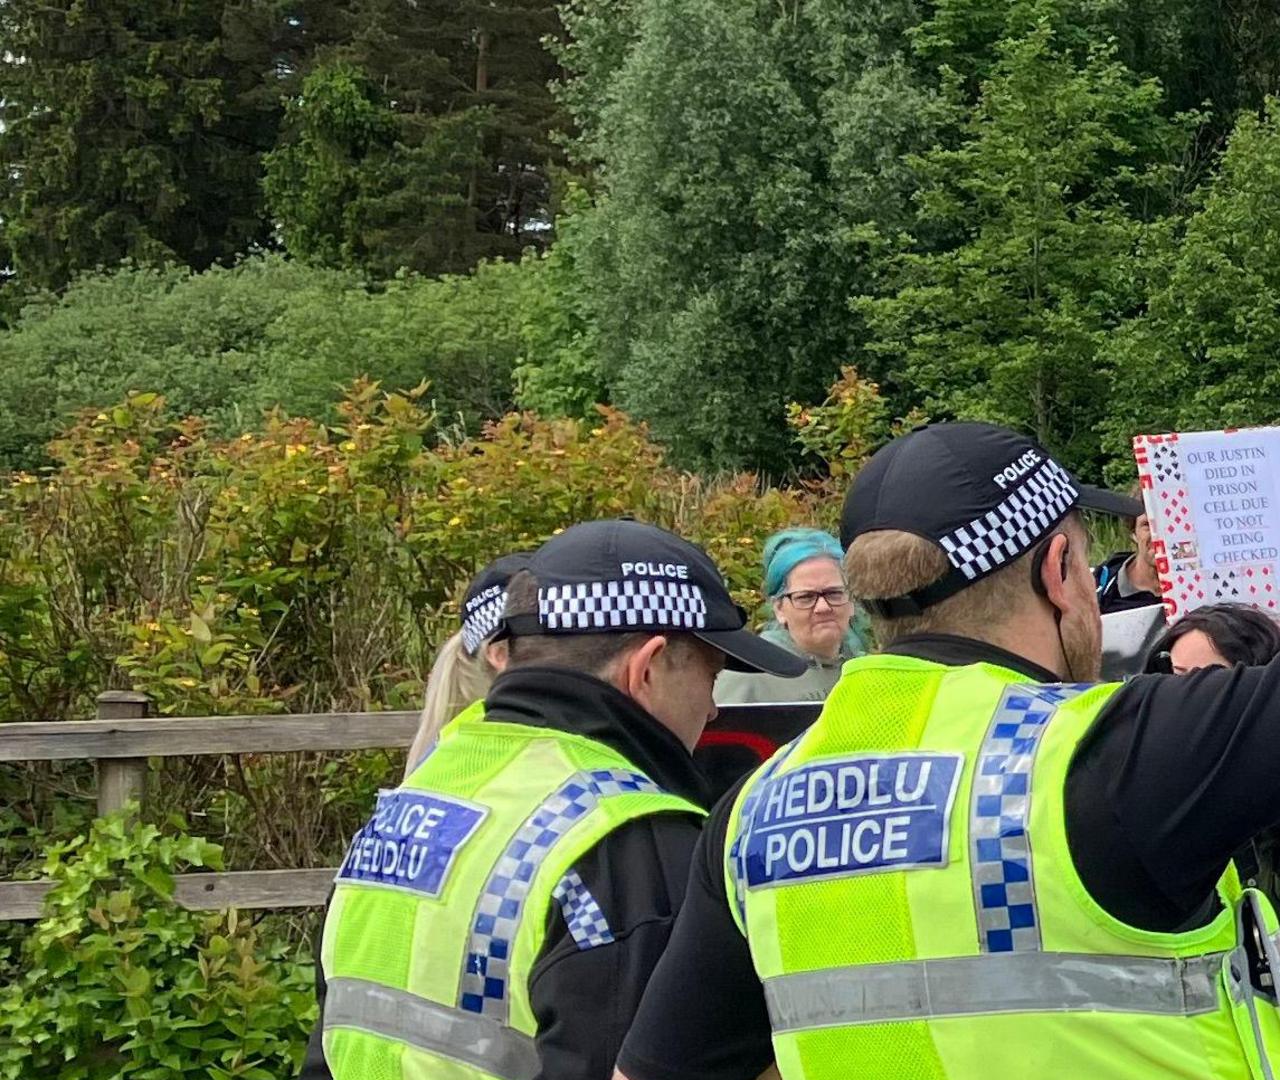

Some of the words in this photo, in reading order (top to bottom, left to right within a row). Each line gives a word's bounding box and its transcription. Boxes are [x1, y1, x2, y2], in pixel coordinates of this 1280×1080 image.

[1187, 451, 1217, 465] OUR
[1220, 447, 1267, 462] JUSTIN
[993, 449, 1041, 489] POLICE
[1204, 467, 1238, 479] DIED
[1240, 465, 1256, 477] IN
[1208, 481, 1258, 496] PRISON
[1203, 500, 1239, 513] CELL
[1241, 497, 1269, 511] DUE
[1216, 517, 1234, 529] TO
[1236, 514, 1264, 528] NOT
[1222, 531, 1264, 546] BEING
[1213, 547, 1278, 564] CHECKED
[621, 562, 689, 579] POLICE
[466, 585, 501, 612] POLICE
[763, 761, 932, 822] HEDDLU
[765, 816, 911, 876] POLICE
[348, 837, 428, 881] HEDDLU
